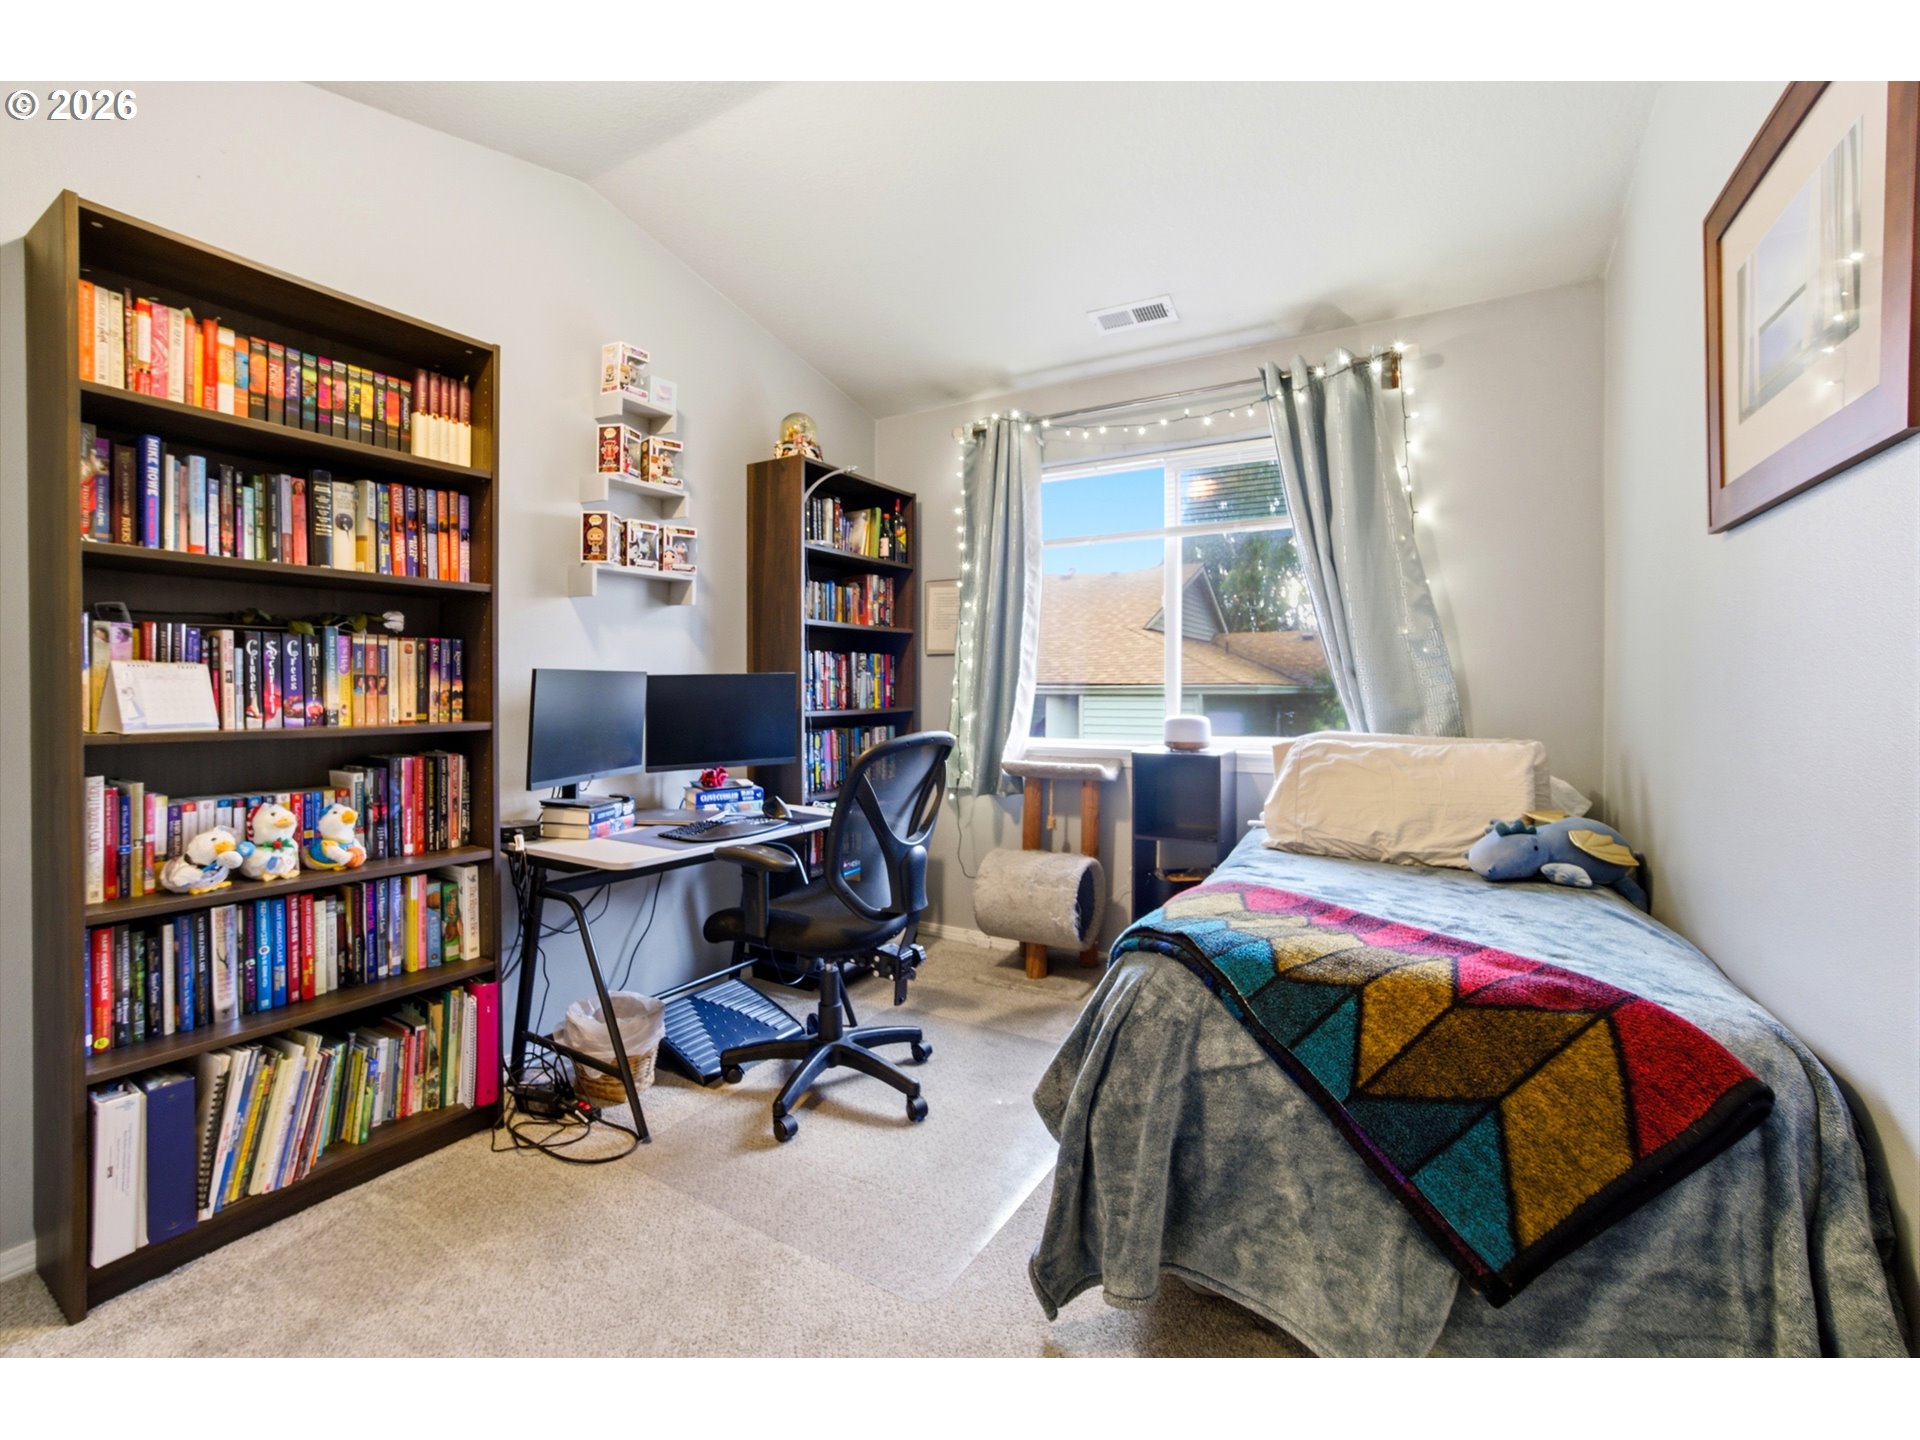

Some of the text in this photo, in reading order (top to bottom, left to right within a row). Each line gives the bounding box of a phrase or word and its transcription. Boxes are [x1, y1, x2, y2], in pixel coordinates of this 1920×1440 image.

[147, 438, 159, 464] MIKE
[147, 466, 159, 497] ROWE
[287, 640, 299, 691] Cress
[307, 643, 319, 701] Winter
